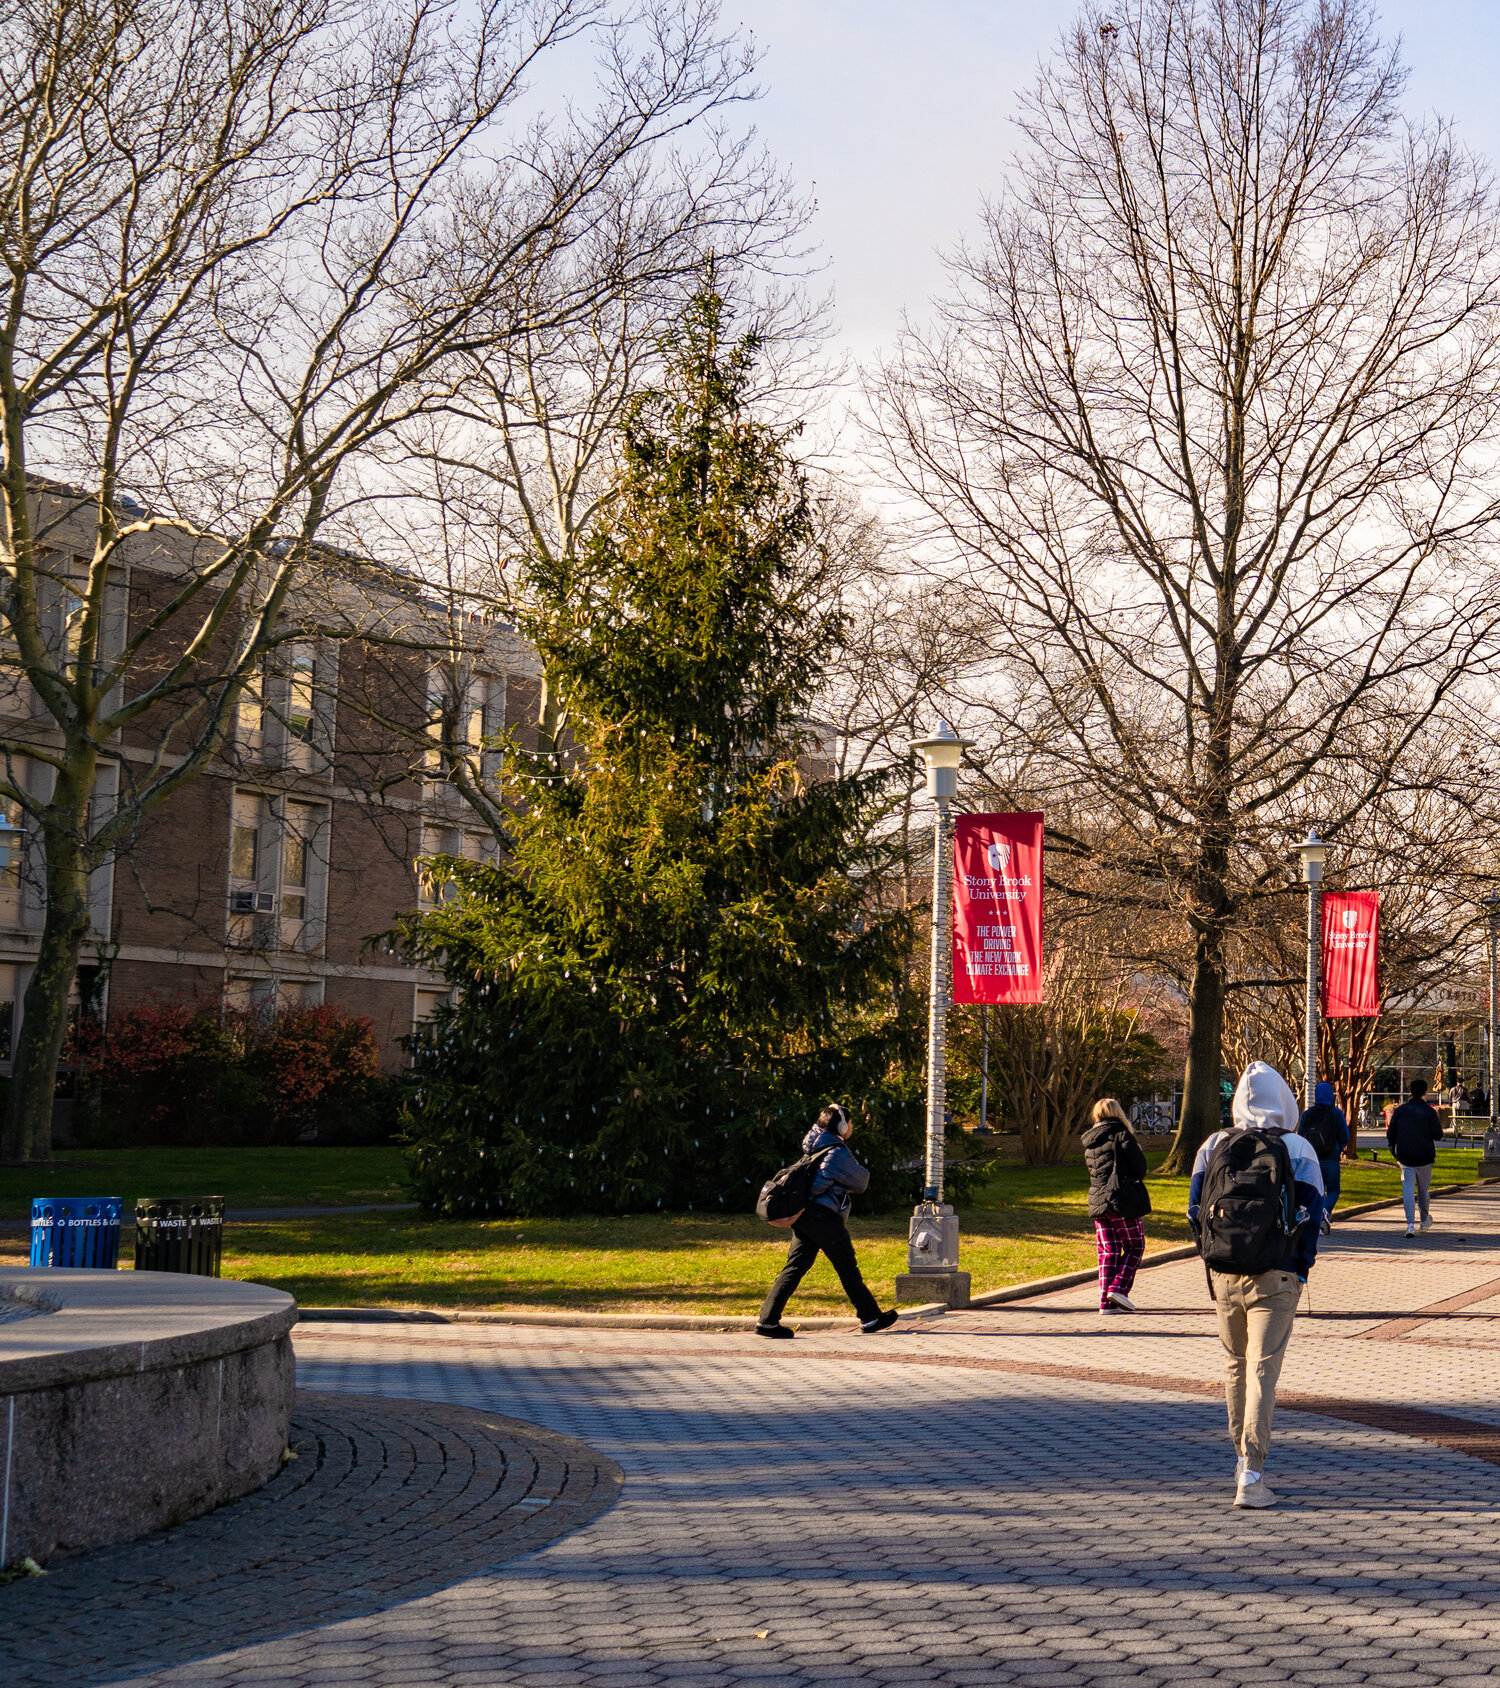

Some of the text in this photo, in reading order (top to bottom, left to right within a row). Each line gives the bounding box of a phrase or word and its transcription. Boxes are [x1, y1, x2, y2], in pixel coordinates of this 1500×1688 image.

[964, 875, 1032, 888] Stony Brook
[969, 888, 1027, 902] University
[977, 925, 1016, 937] THE POWER
[1328, 931, 1372, 941] Stony Brook
[983, 938, 1011, 950] DRIVING
[1331, 940, 1368, 949] University
[970, 951, 1022, 963] THE NEW YORK
[966, 963, 1029, 976] CLIMATE EXCHANGE
[68, 1219, 102, 1227] BOTTLES
[159, 1217, 219, 1228] WASTE WASTE
